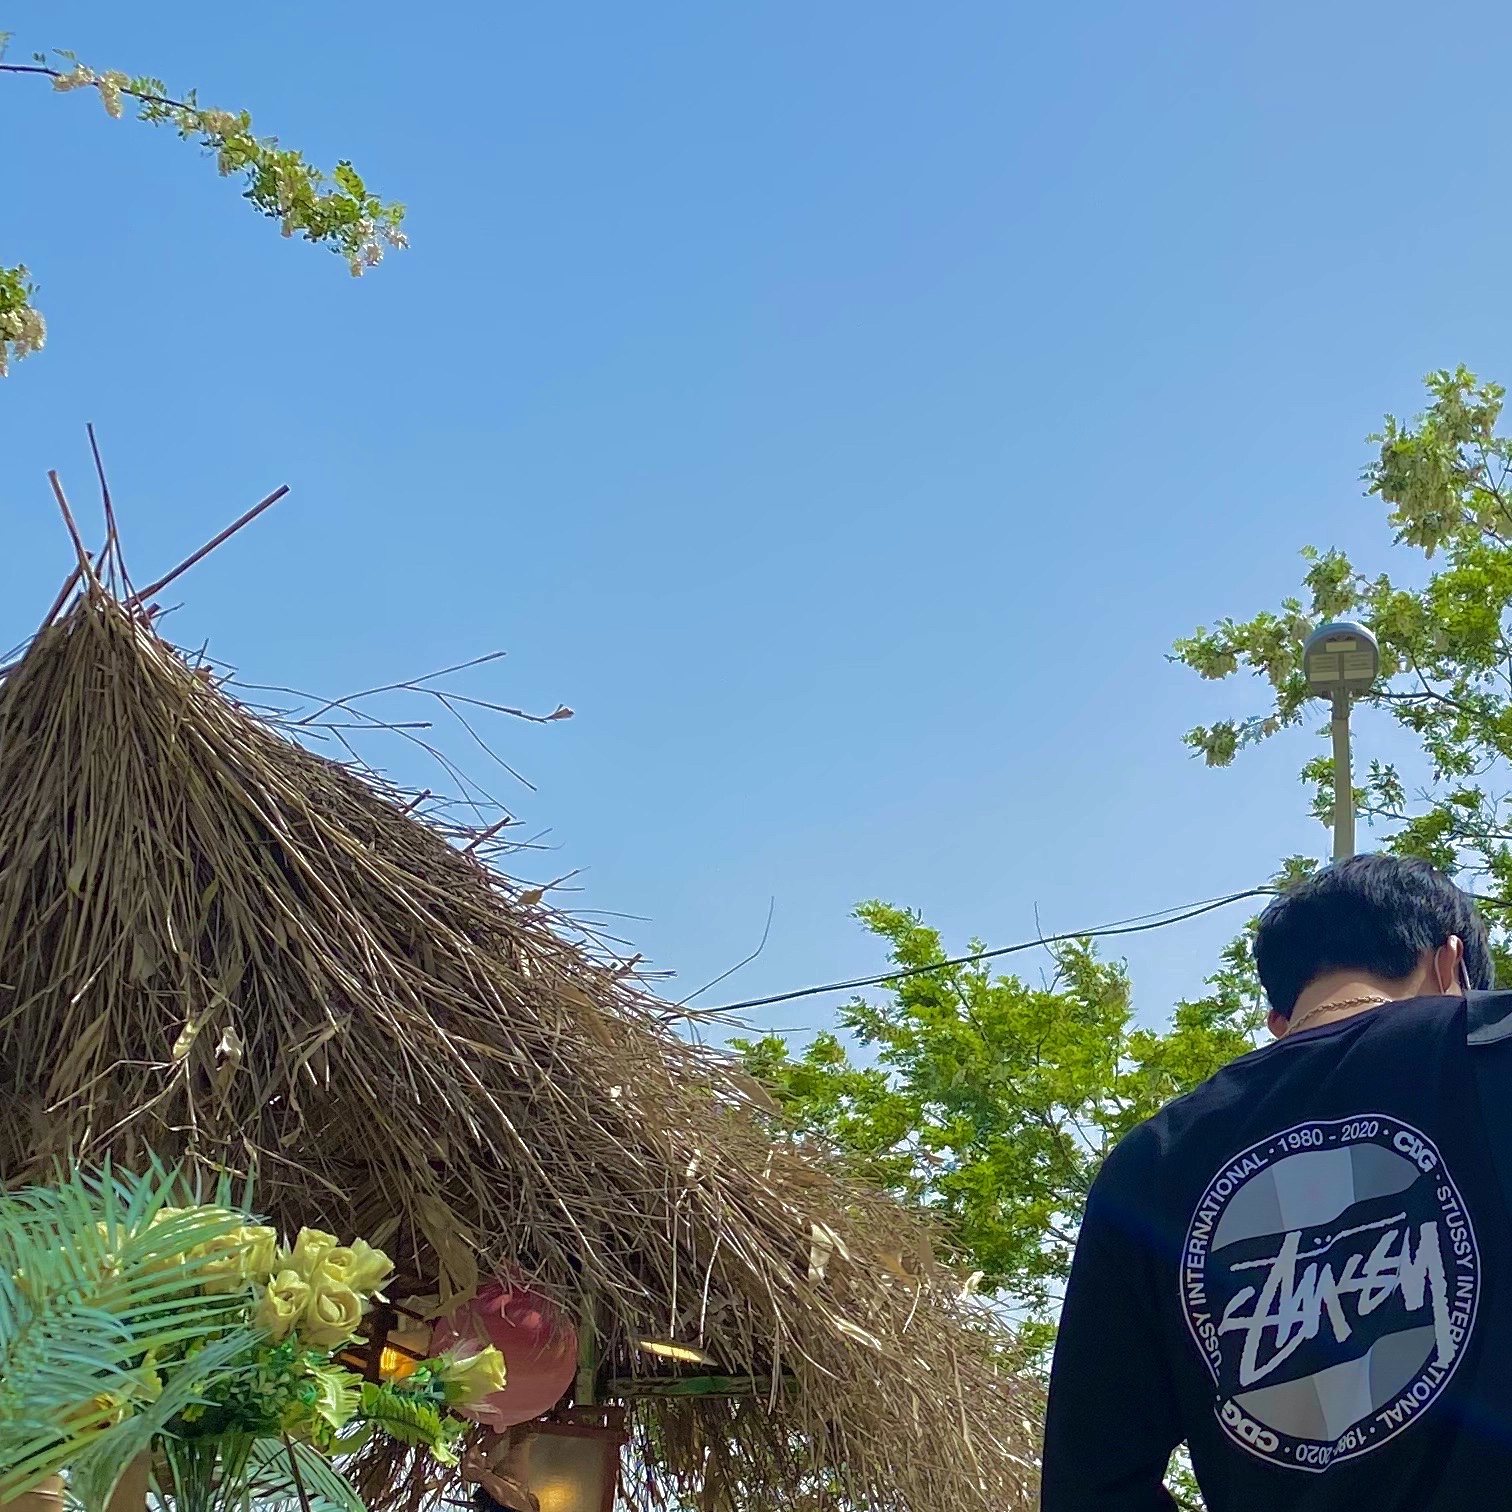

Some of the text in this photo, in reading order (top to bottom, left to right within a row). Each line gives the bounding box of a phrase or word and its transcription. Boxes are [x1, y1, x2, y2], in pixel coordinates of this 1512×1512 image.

[1277, 1128, 1323, 1152] 1980
[1341, 1121, 1379, 1142] 2020
[1393, 1130, 1438, 1172] CDG
[1186, 1152, 1268, 1306] INTERNATIONAL
[1436, 1185, 1474, 1270] STUSSY
[1192, 1312, 1223, 1378] USSY
[1376, 1275, 1474, 1429] INTERTIONAL
[1220, 1400, 1279, 1452] CDG
